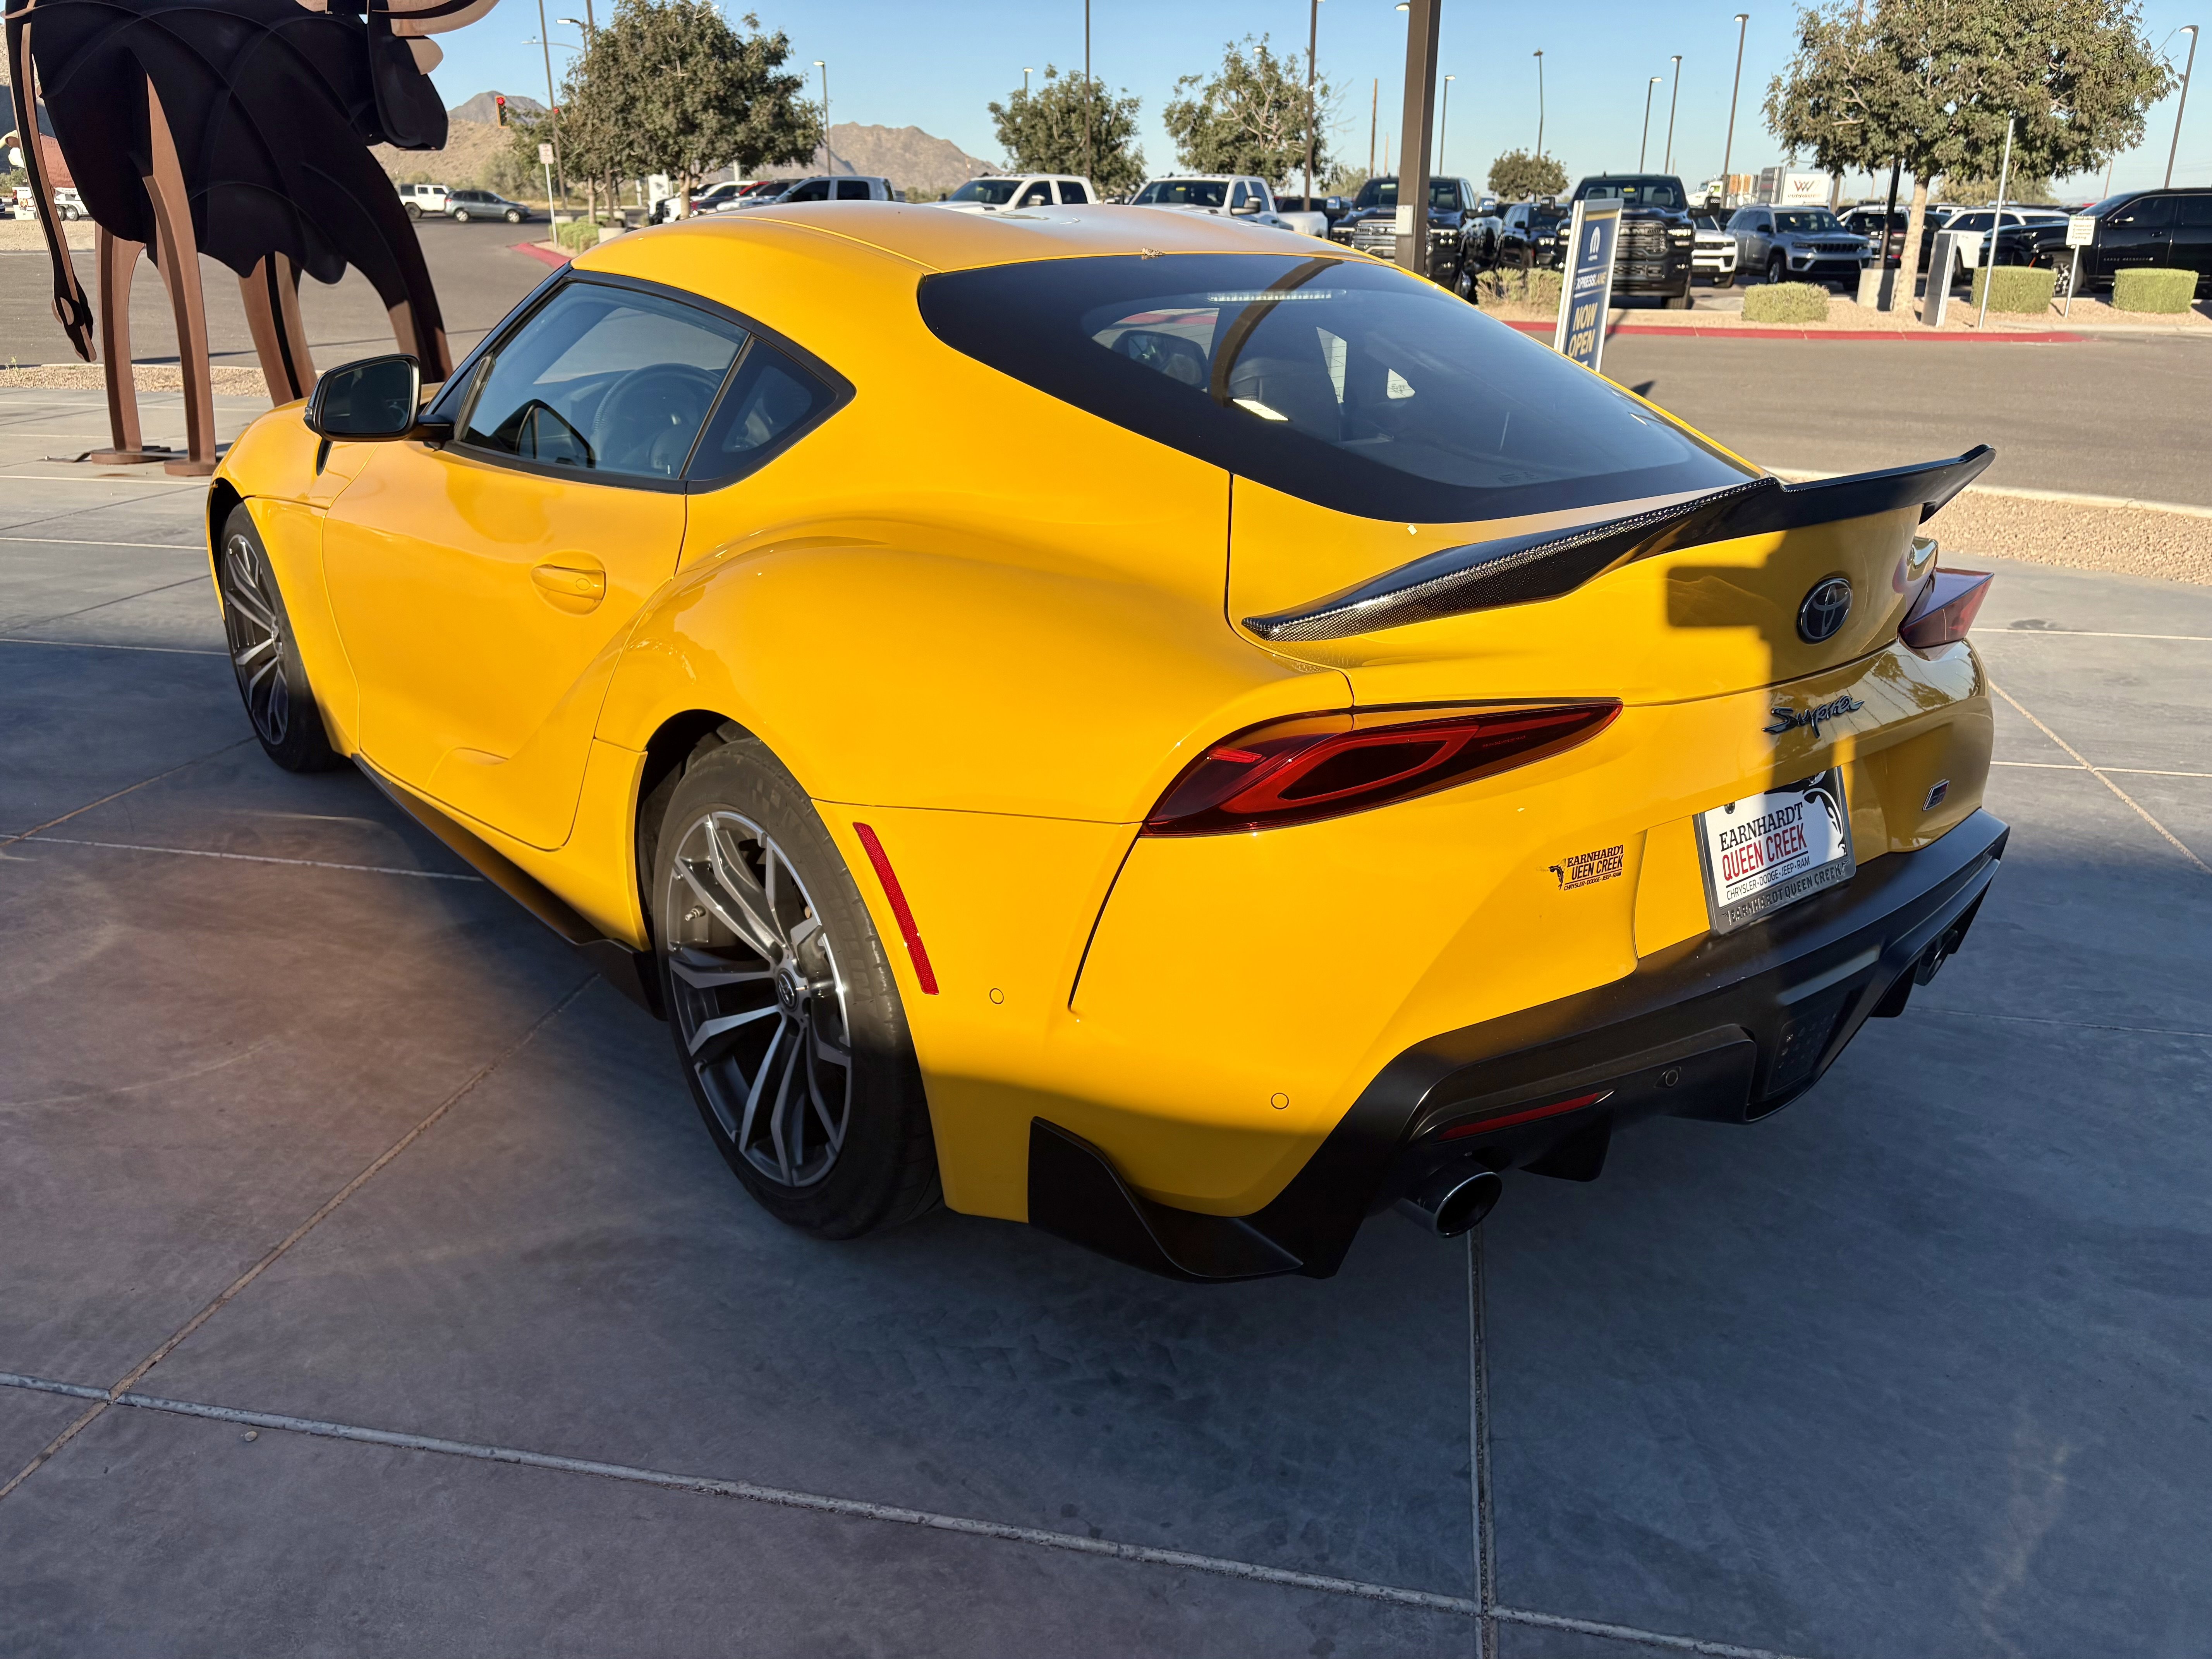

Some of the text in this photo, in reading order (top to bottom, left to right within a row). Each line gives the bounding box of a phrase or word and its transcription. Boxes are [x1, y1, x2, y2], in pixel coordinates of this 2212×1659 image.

[1572, 302, 1598, 332] NOW
[1568, 329, 1596, 358] OPEN
[1762, 695, 1865, 738] Supra
[1719, 802, 1803, 852] EARNHARDT
[1567, 844, 1624, 868] EARNHARDT
[1571, 854, 1624, 880] UEEN CREEK
[1722, 823, 1807, 881] QUEEN CREEK
[1730, 865, 1841, 922] EARNHARDT QUEEN CREEK
